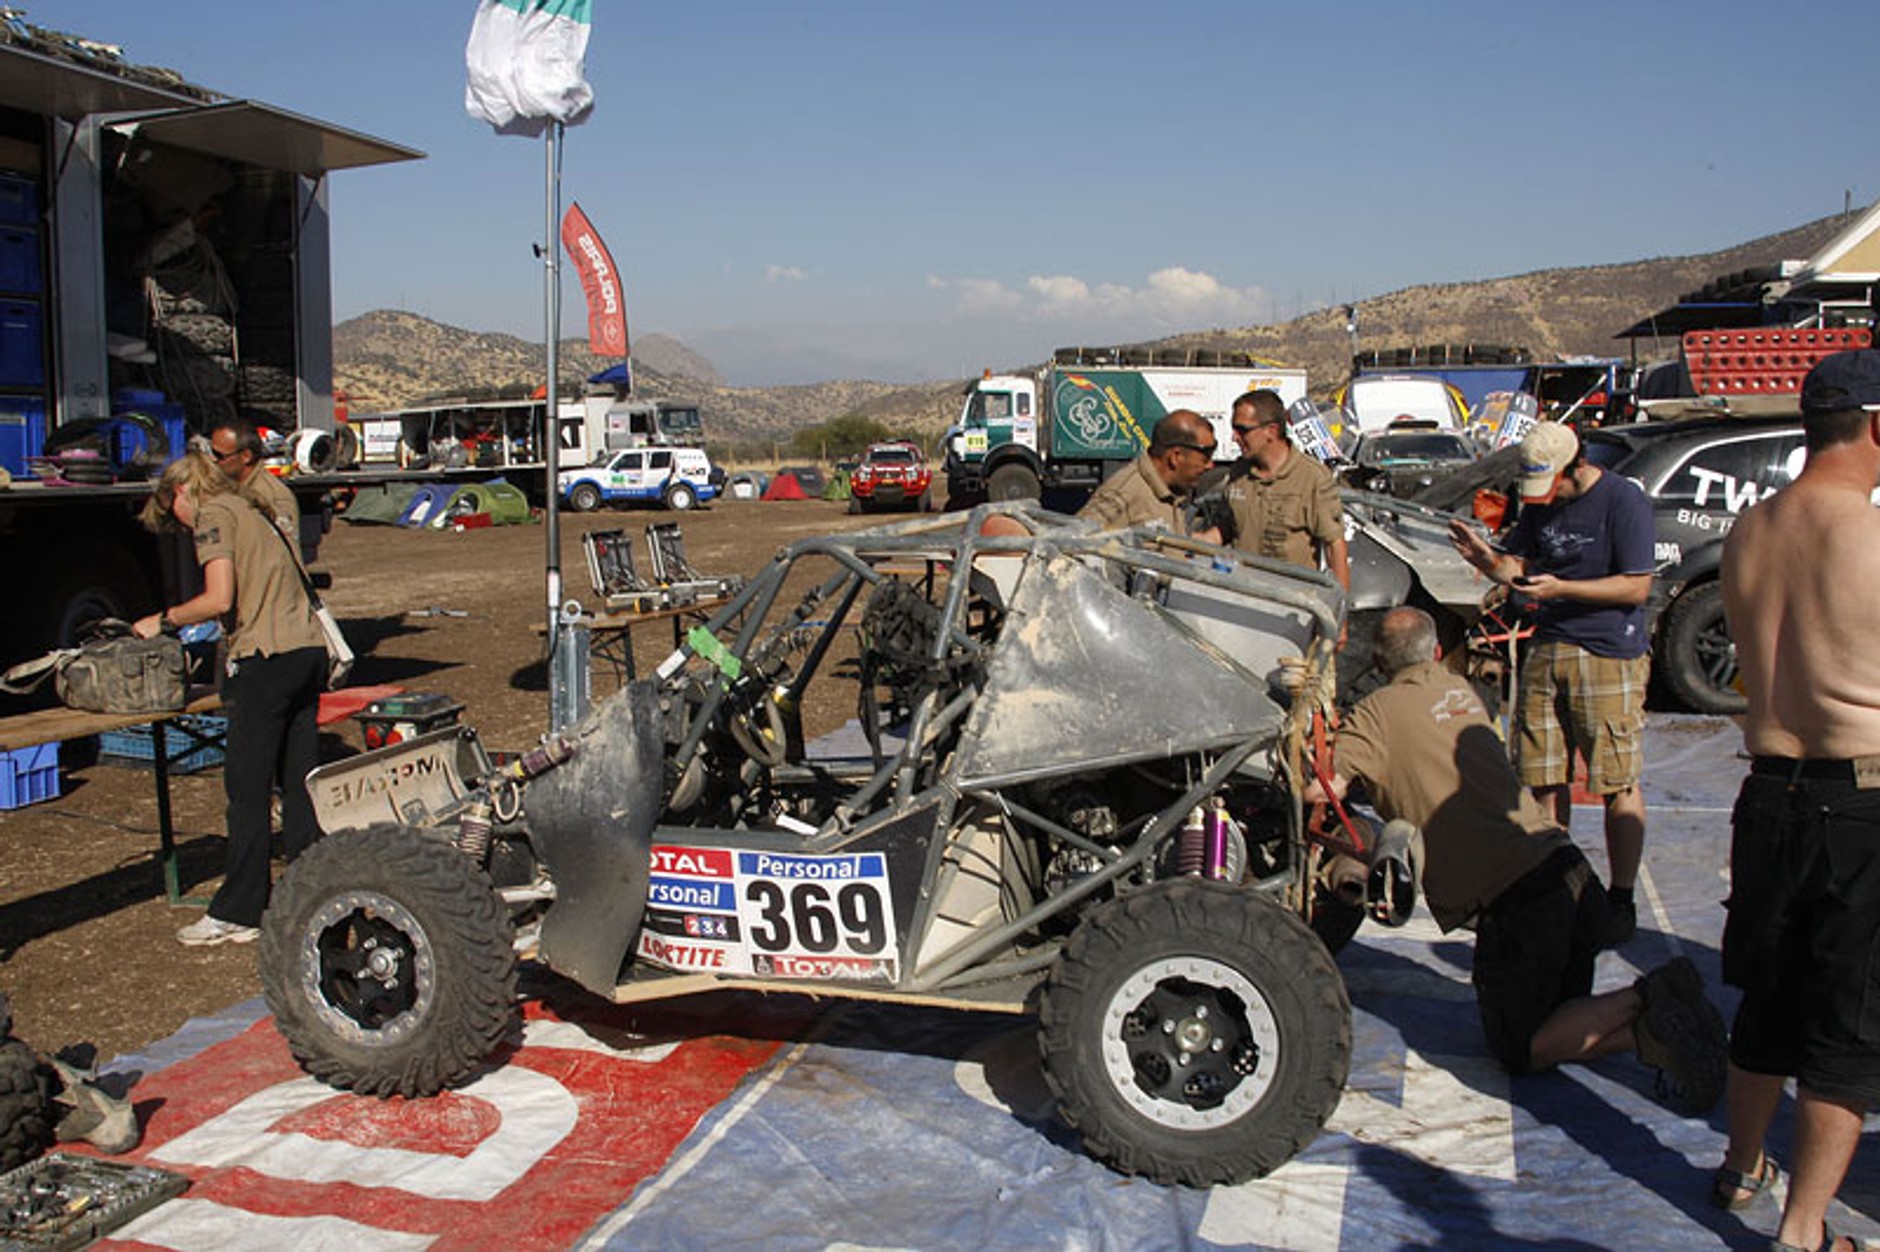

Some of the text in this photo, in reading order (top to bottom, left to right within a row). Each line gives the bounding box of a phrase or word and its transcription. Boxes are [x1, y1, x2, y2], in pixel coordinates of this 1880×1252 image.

[1677, 508, 1712, 530] BIG
[757, 855, 860, 878] Personal
[649, 883, 719, 906] rsonal
[746, 880, 887, 955] 369
